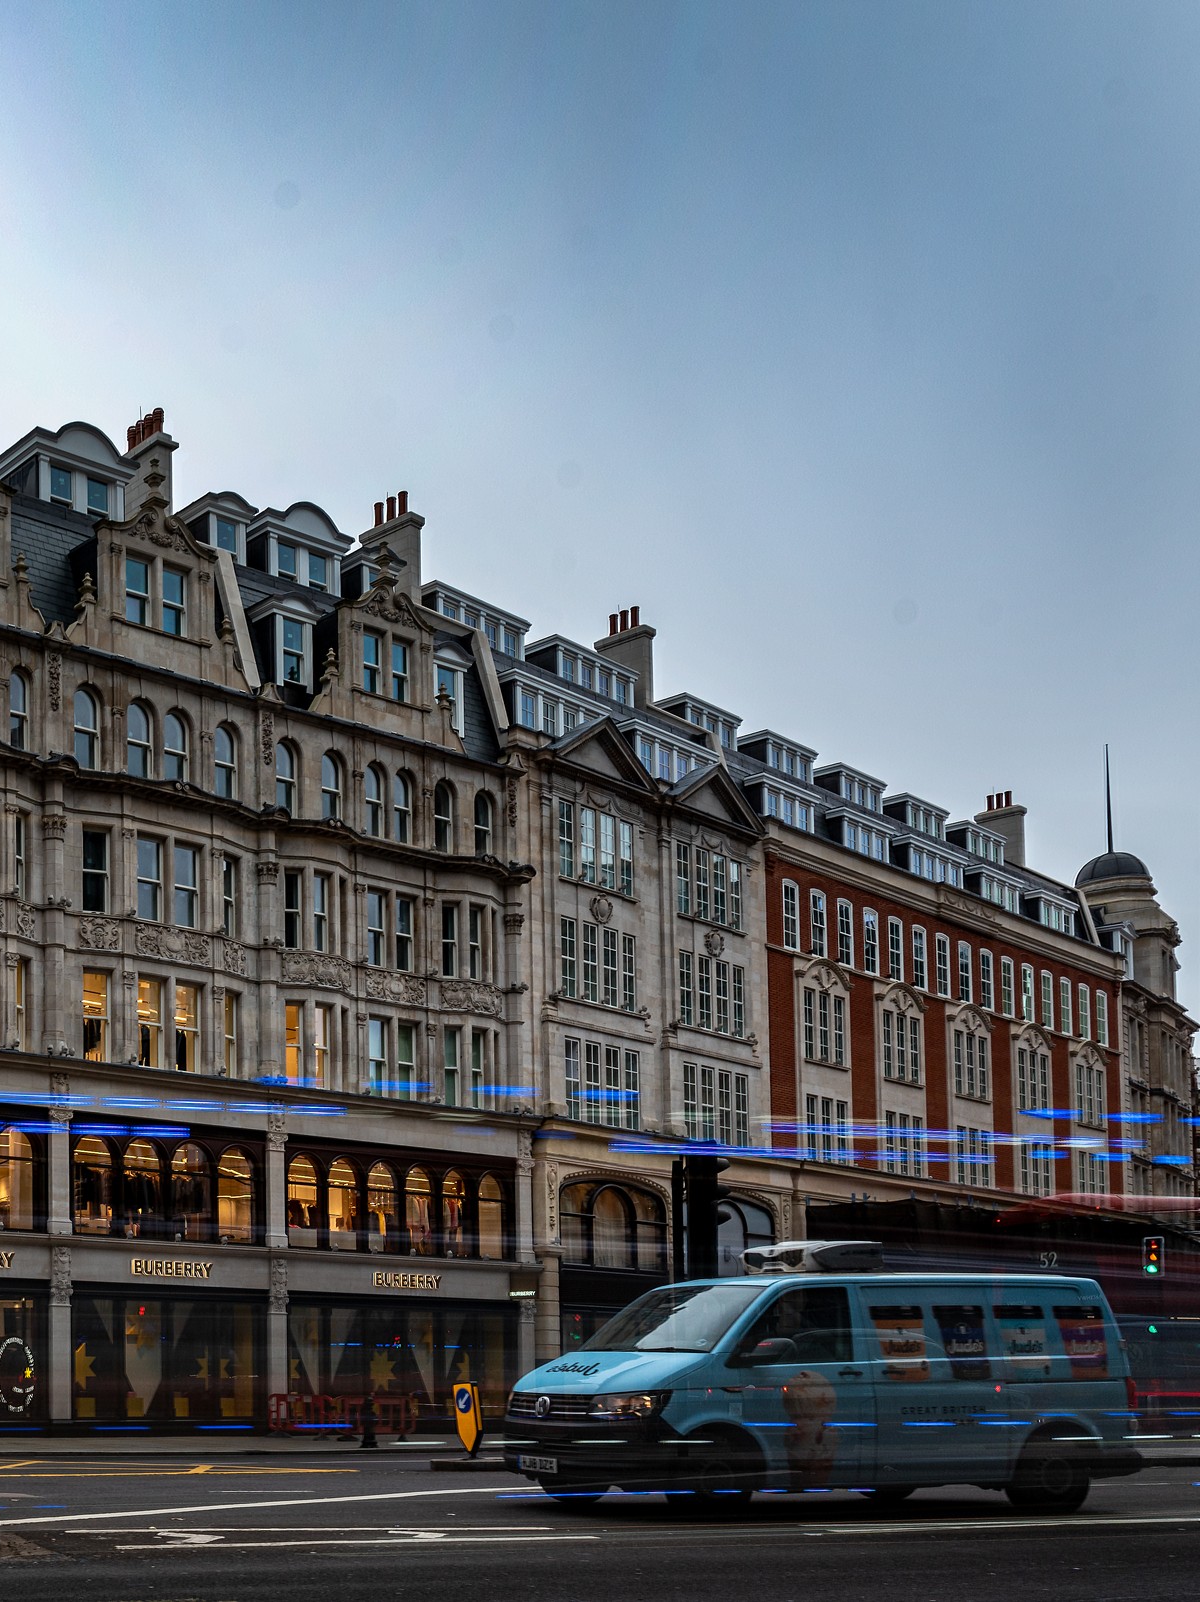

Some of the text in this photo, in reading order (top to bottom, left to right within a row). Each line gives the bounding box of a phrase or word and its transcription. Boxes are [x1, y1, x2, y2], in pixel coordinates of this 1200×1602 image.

[1039, 1252, 1058, 1268] 52
[131, 1259, 213, 1279] BURBERRY
[373, 1272, 441, 1289] BURBERRY
[902, 1405, 987, 1415] GREAT BRITISH
